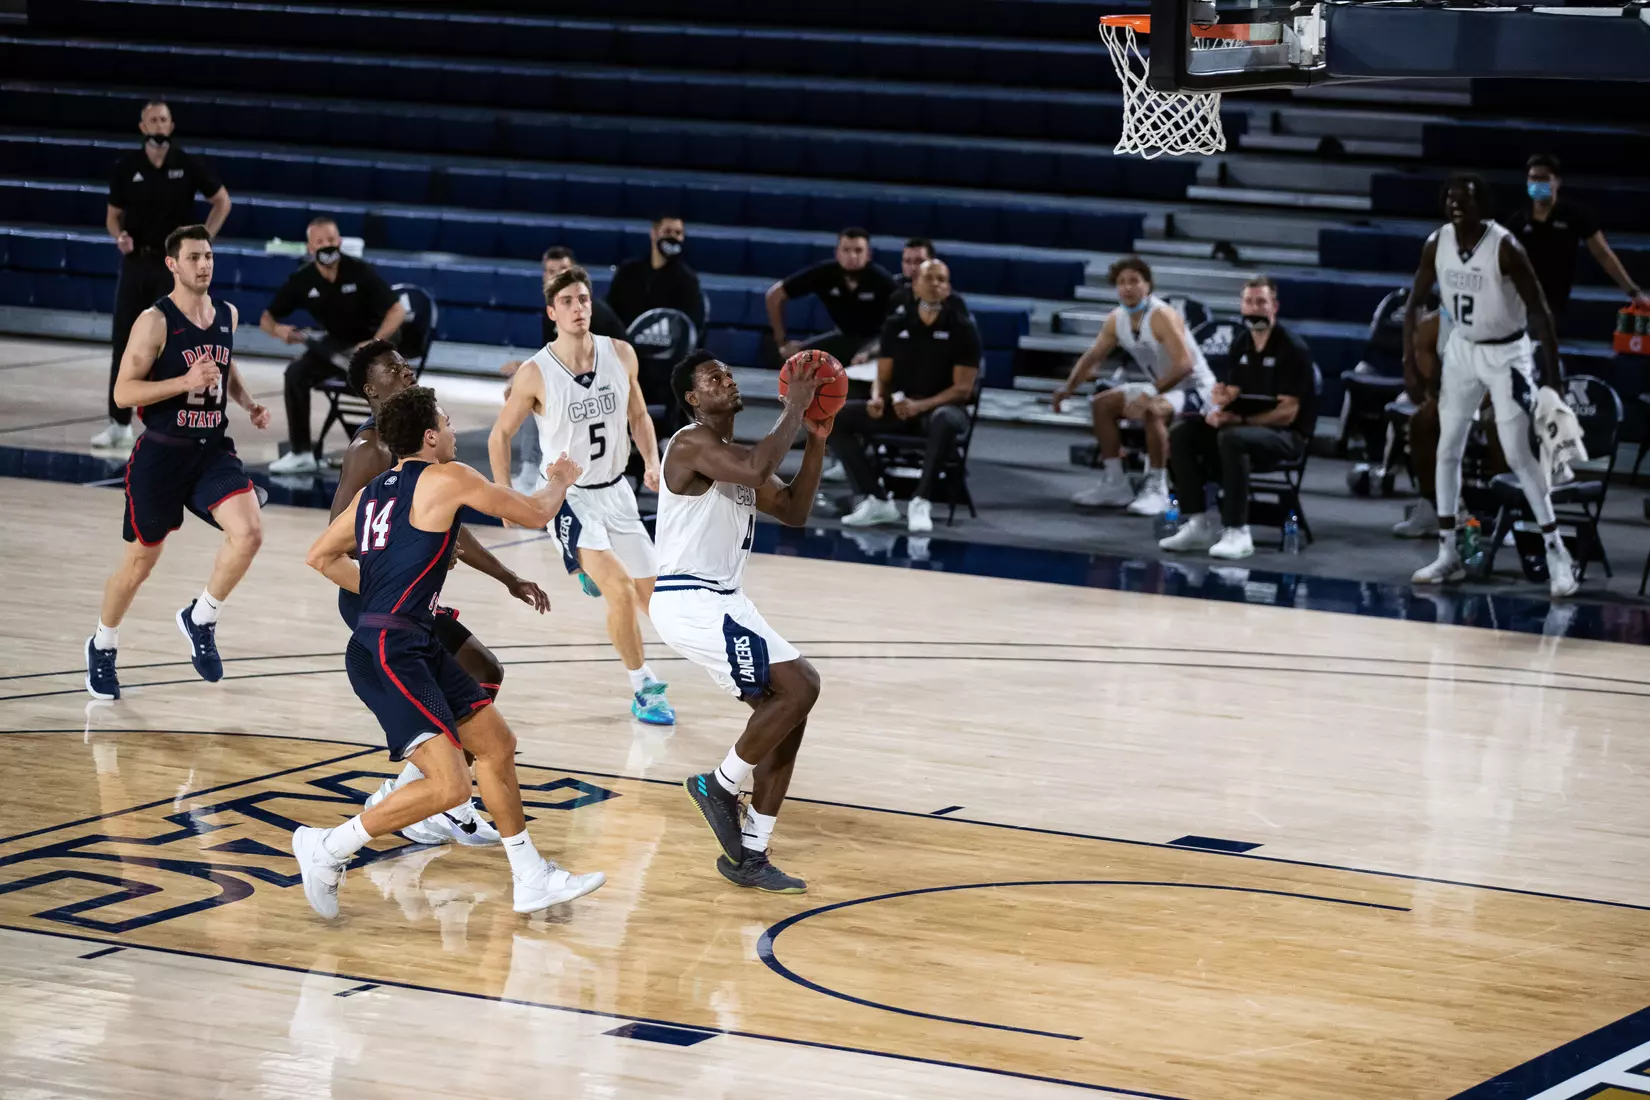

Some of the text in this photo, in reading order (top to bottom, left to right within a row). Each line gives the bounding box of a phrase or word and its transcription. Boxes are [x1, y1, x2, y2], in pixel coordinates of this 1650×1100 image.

[1453, 293, 1475, 327] 12
[182, 344, 229, 367] DIXIE
[177, 410, 222, 428] STATE
[568, 392, 617, 423] CBU
[589, 421, 606, 461] 5
[361, 497, 397, 555] 14
[733, 635, 756, 683] LANCERS
